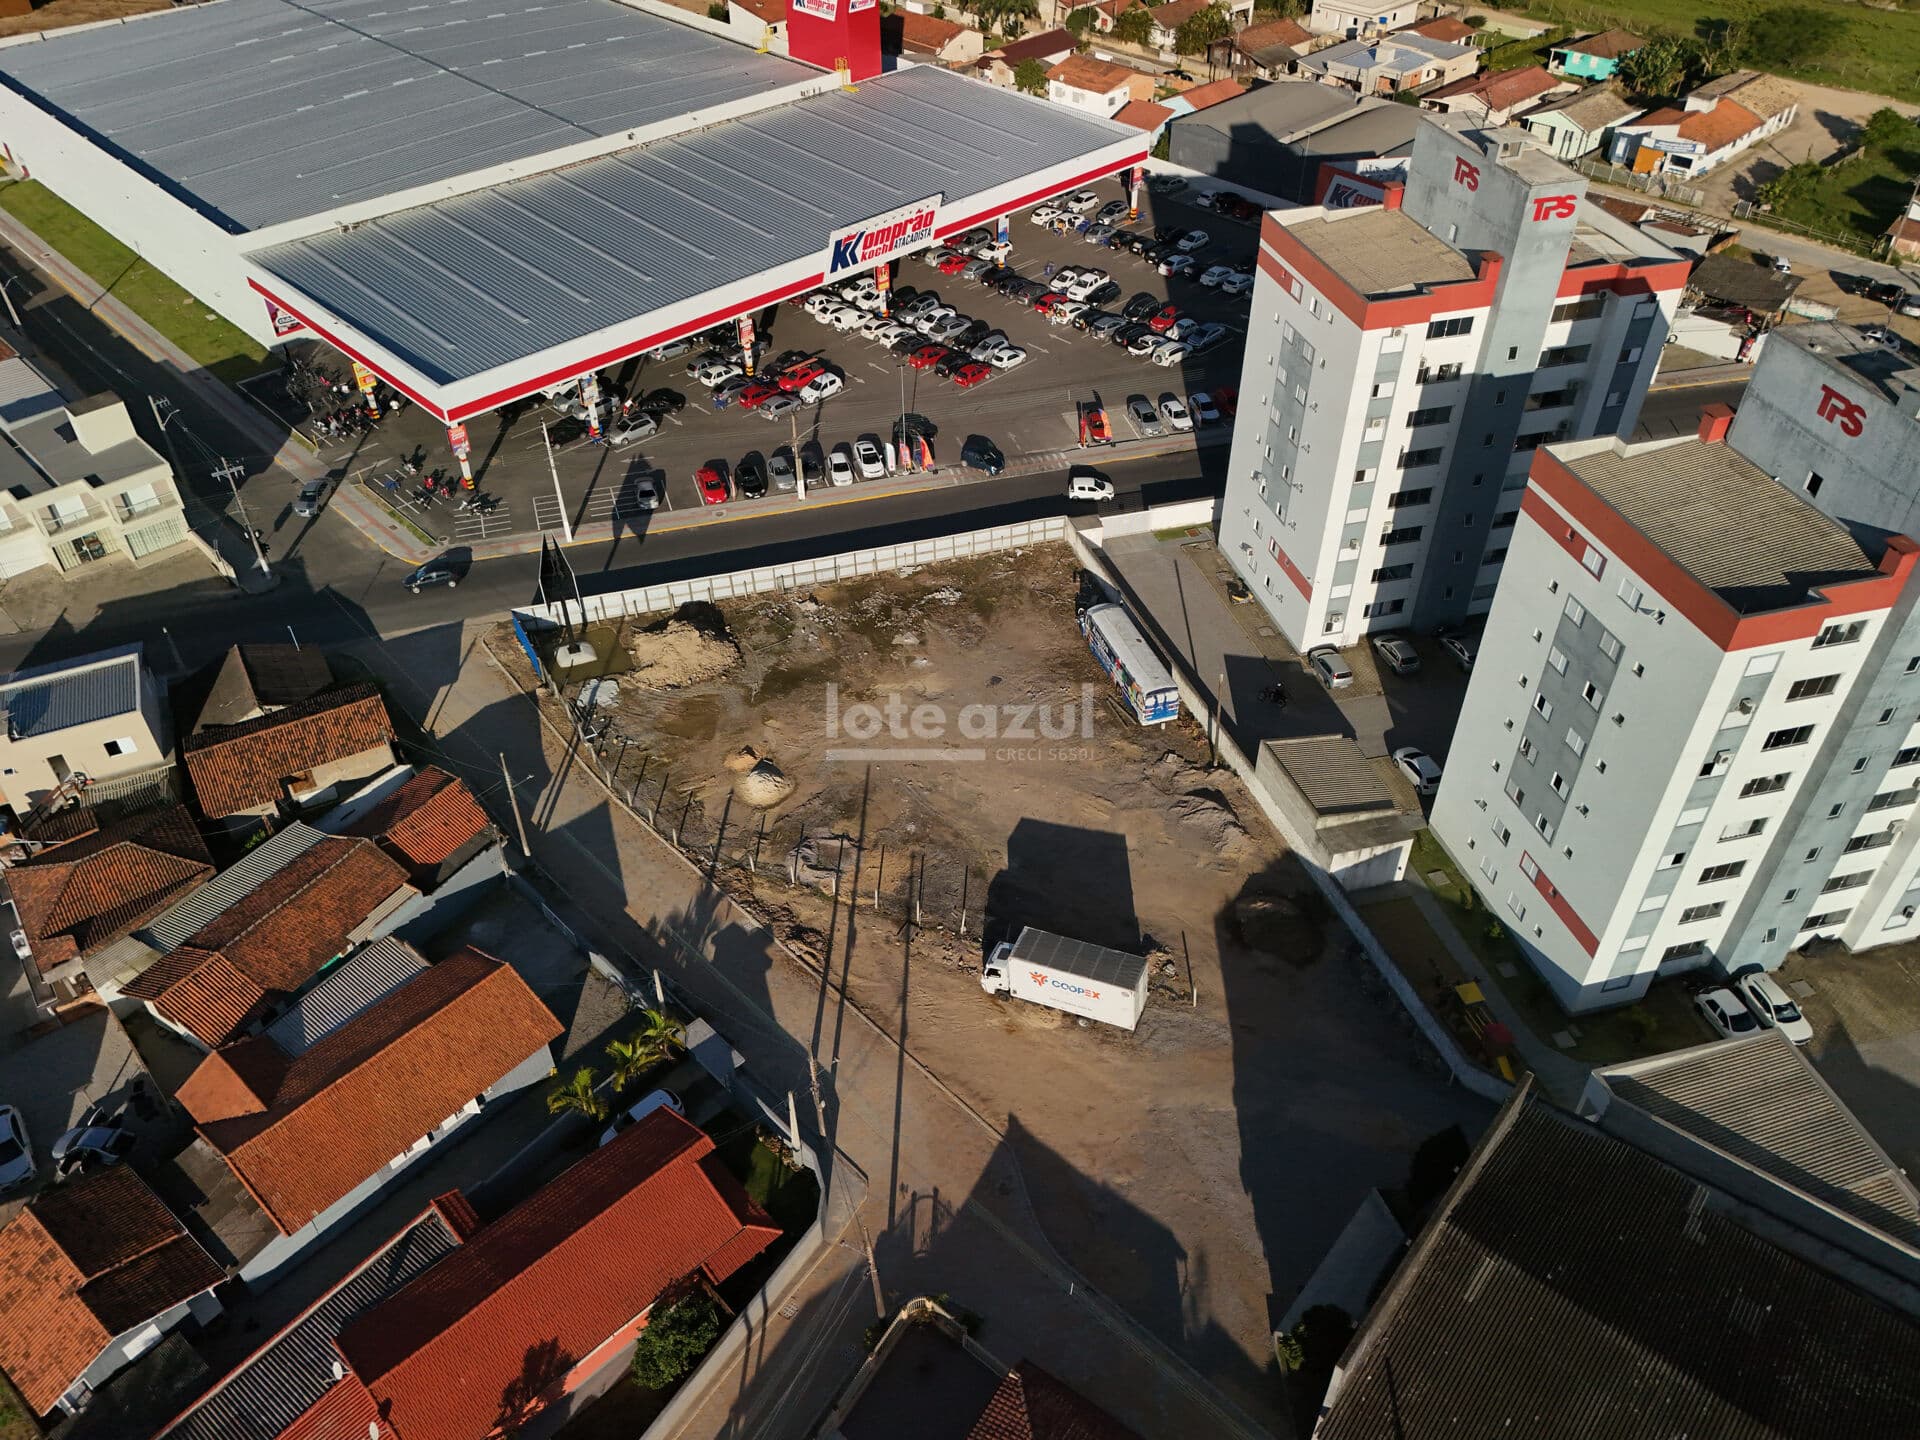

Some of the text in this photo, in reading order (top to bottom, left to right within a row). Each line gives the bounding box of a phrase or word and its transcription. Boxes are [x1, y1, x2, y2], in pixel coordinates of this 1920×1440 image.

[1454, 155, 1480, 192] TPS
[1533, 195, 1577, 221] TPS
[894, 227, 931, 249] ATACADISTA
[1817, 384, 1867, 437] TPS
[1051, 980, 1100, 999] COOPEX
